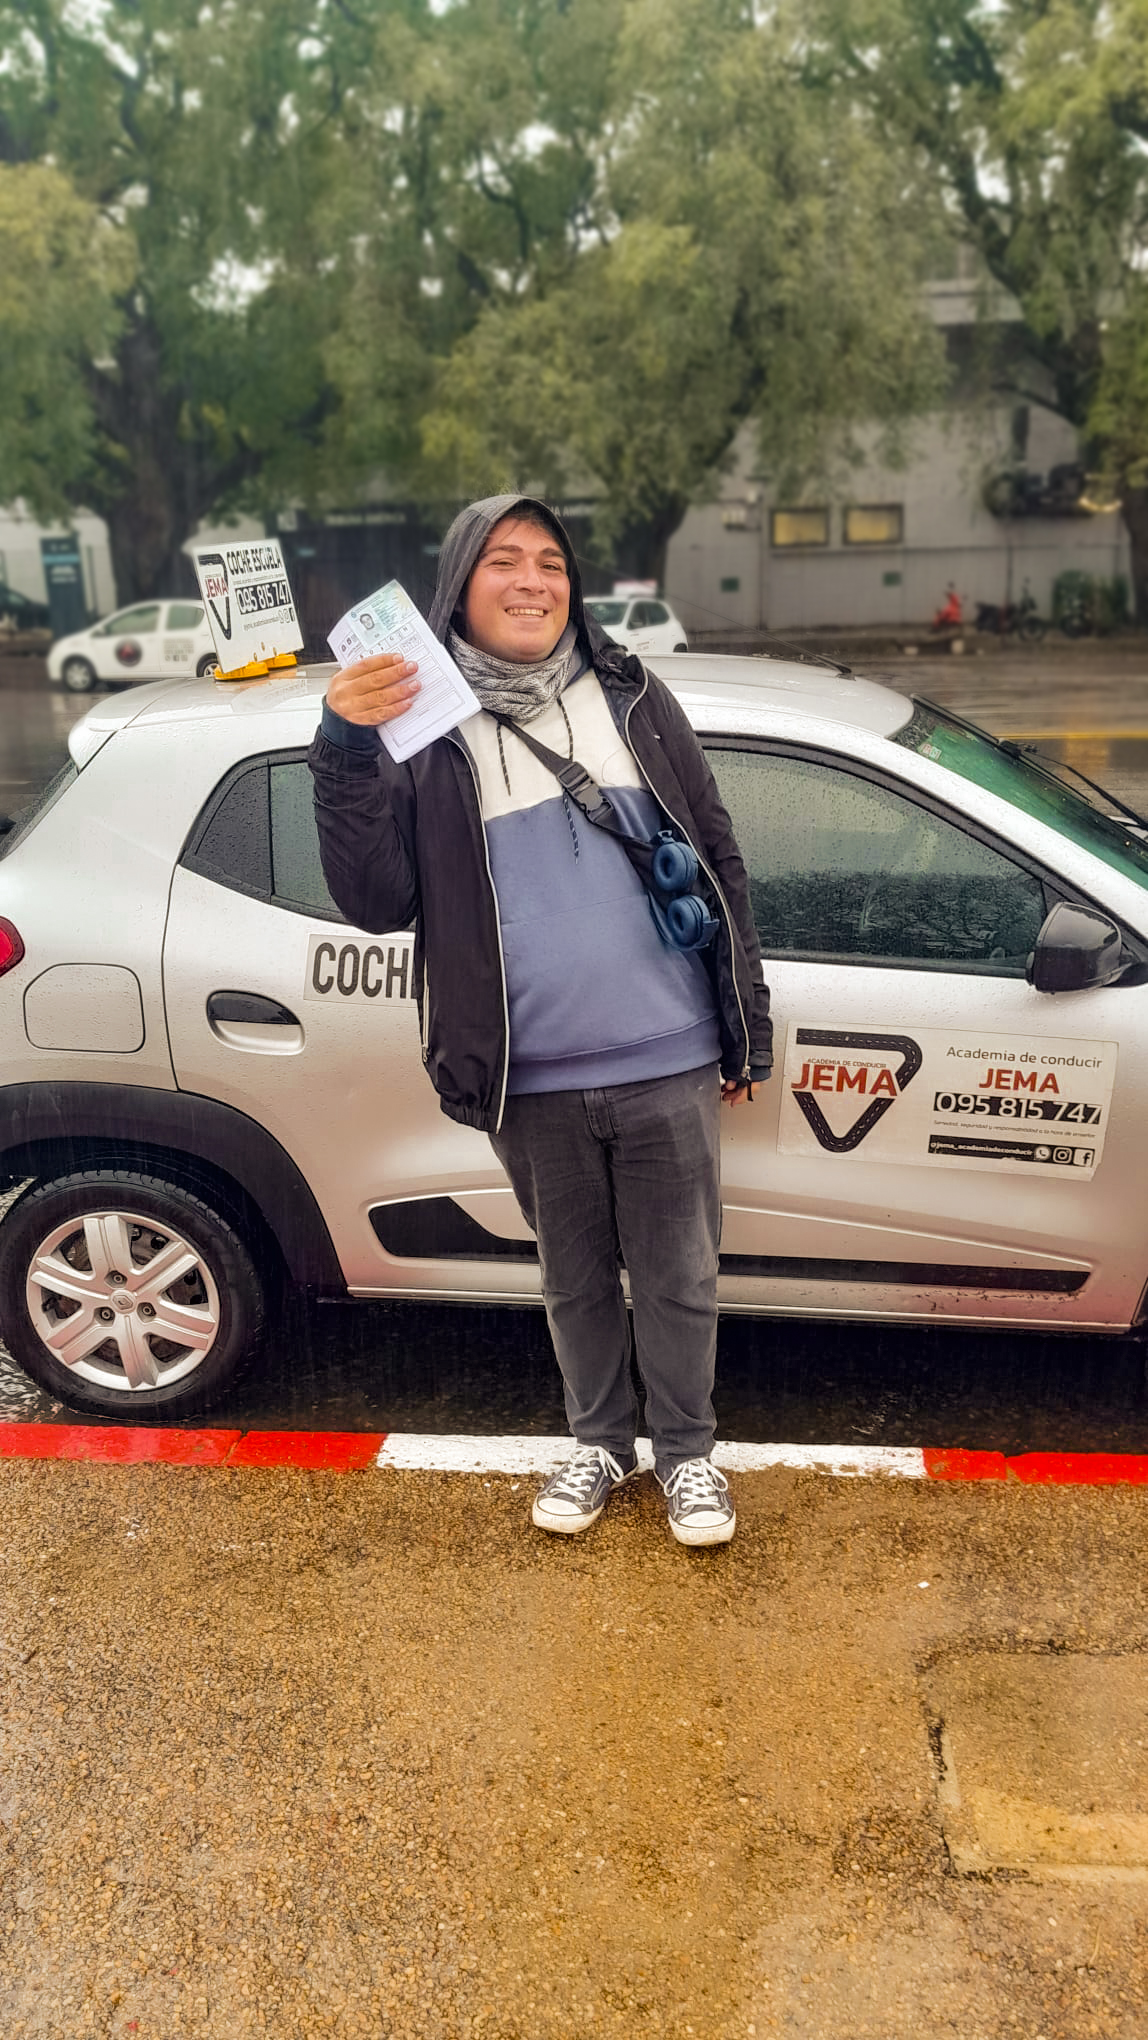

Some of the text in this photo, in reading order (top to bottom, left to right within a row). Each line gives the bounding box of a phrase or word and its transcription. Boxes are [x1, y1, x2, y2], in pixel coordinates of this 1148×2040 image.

[226, 547, 283, 575] COCHE ESCUELA
[205, 577, 229, 599] JEMA
[236, 581, 290, 613] 095 815 747
[312, 942, 417, 999] COCH
[946, 1047, 1103, 1068] Academia de conducir
[791, 1063, 897, 1096] JEMA
[979, 1068, 1060, 1094] JEMA
[936, 1092, 1103, 1124] 095 815 747
